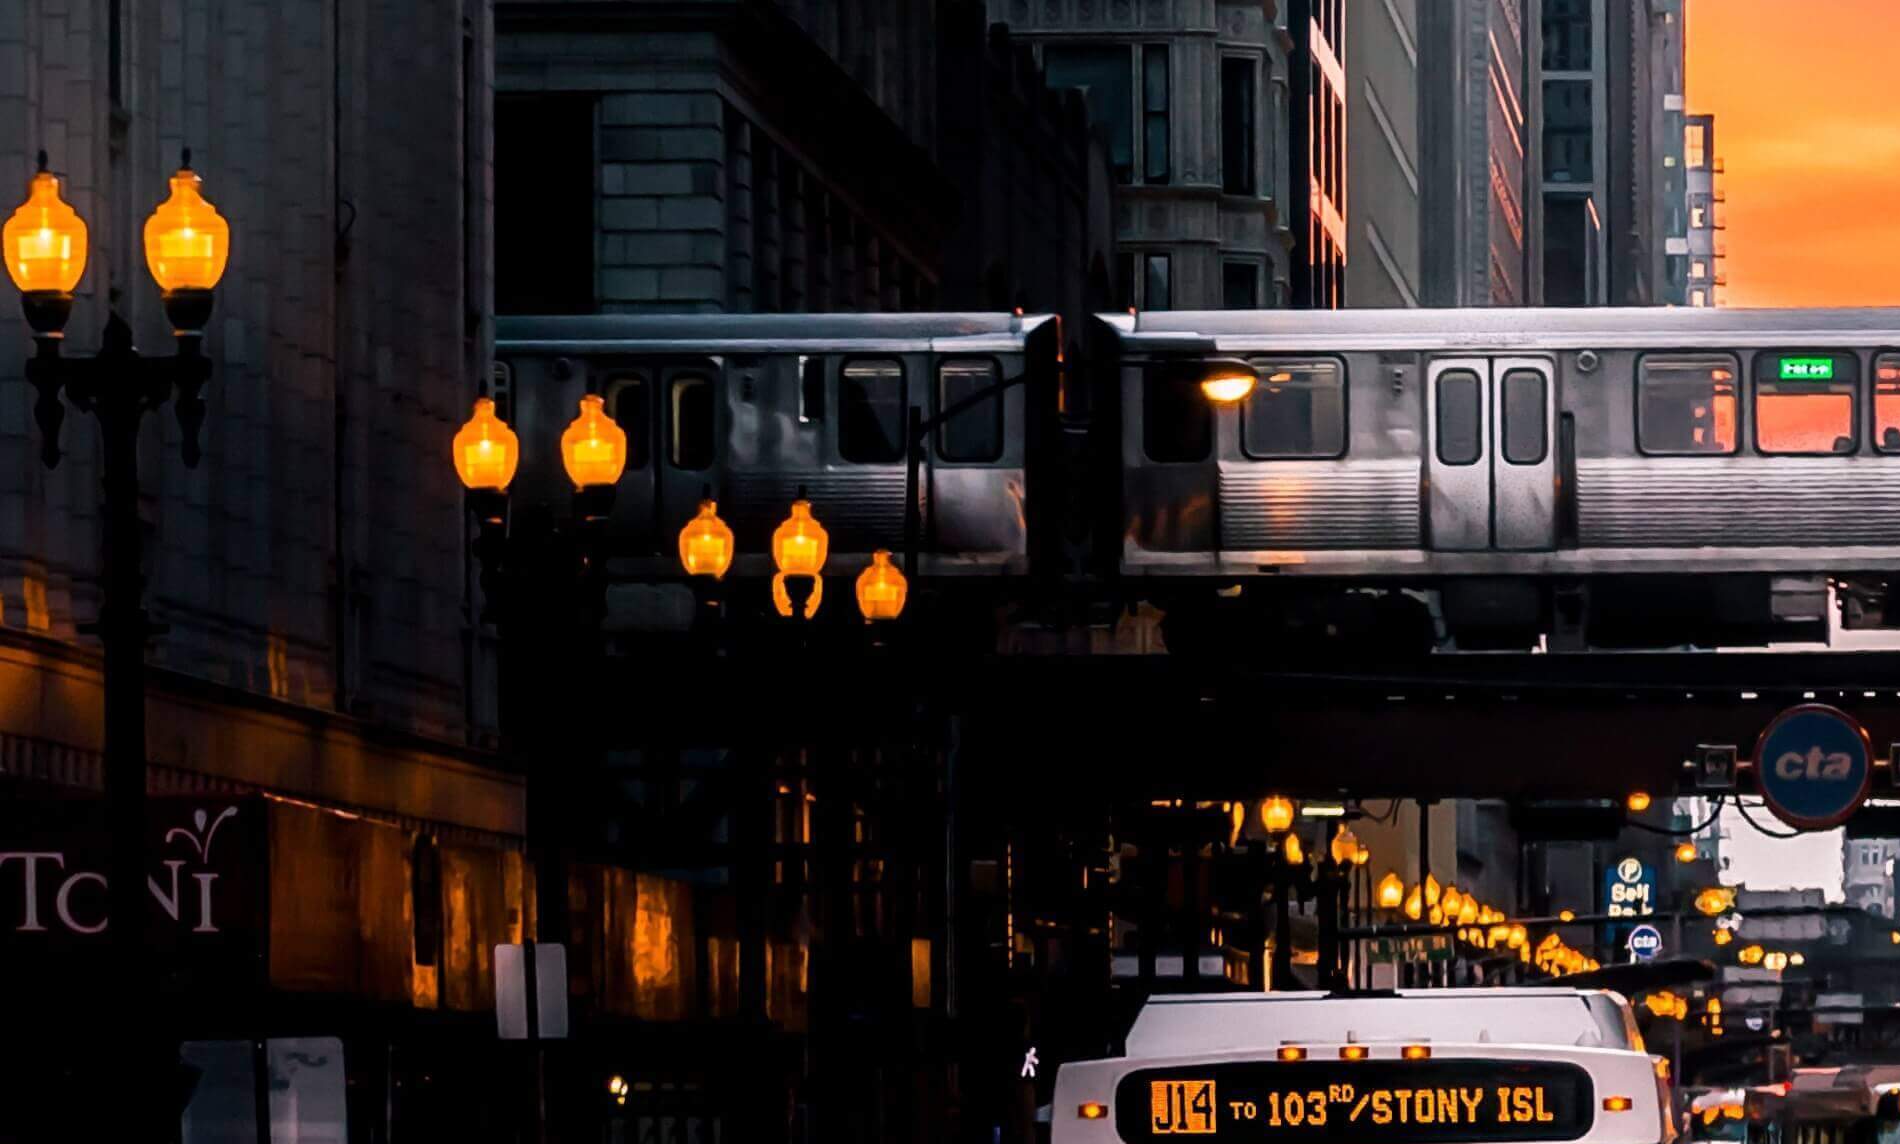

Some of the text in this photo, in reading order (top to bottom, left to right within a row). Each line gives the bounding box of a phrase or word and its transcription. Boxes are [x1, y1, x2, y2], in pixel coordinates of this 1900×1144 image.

[1775, 746, 1852, 779] cta
[1153, 1082, 1215, 1131] J14
[1229, 1102, 1257, 1120] TO
[1497, 1087, 1554, 1122] ISL
